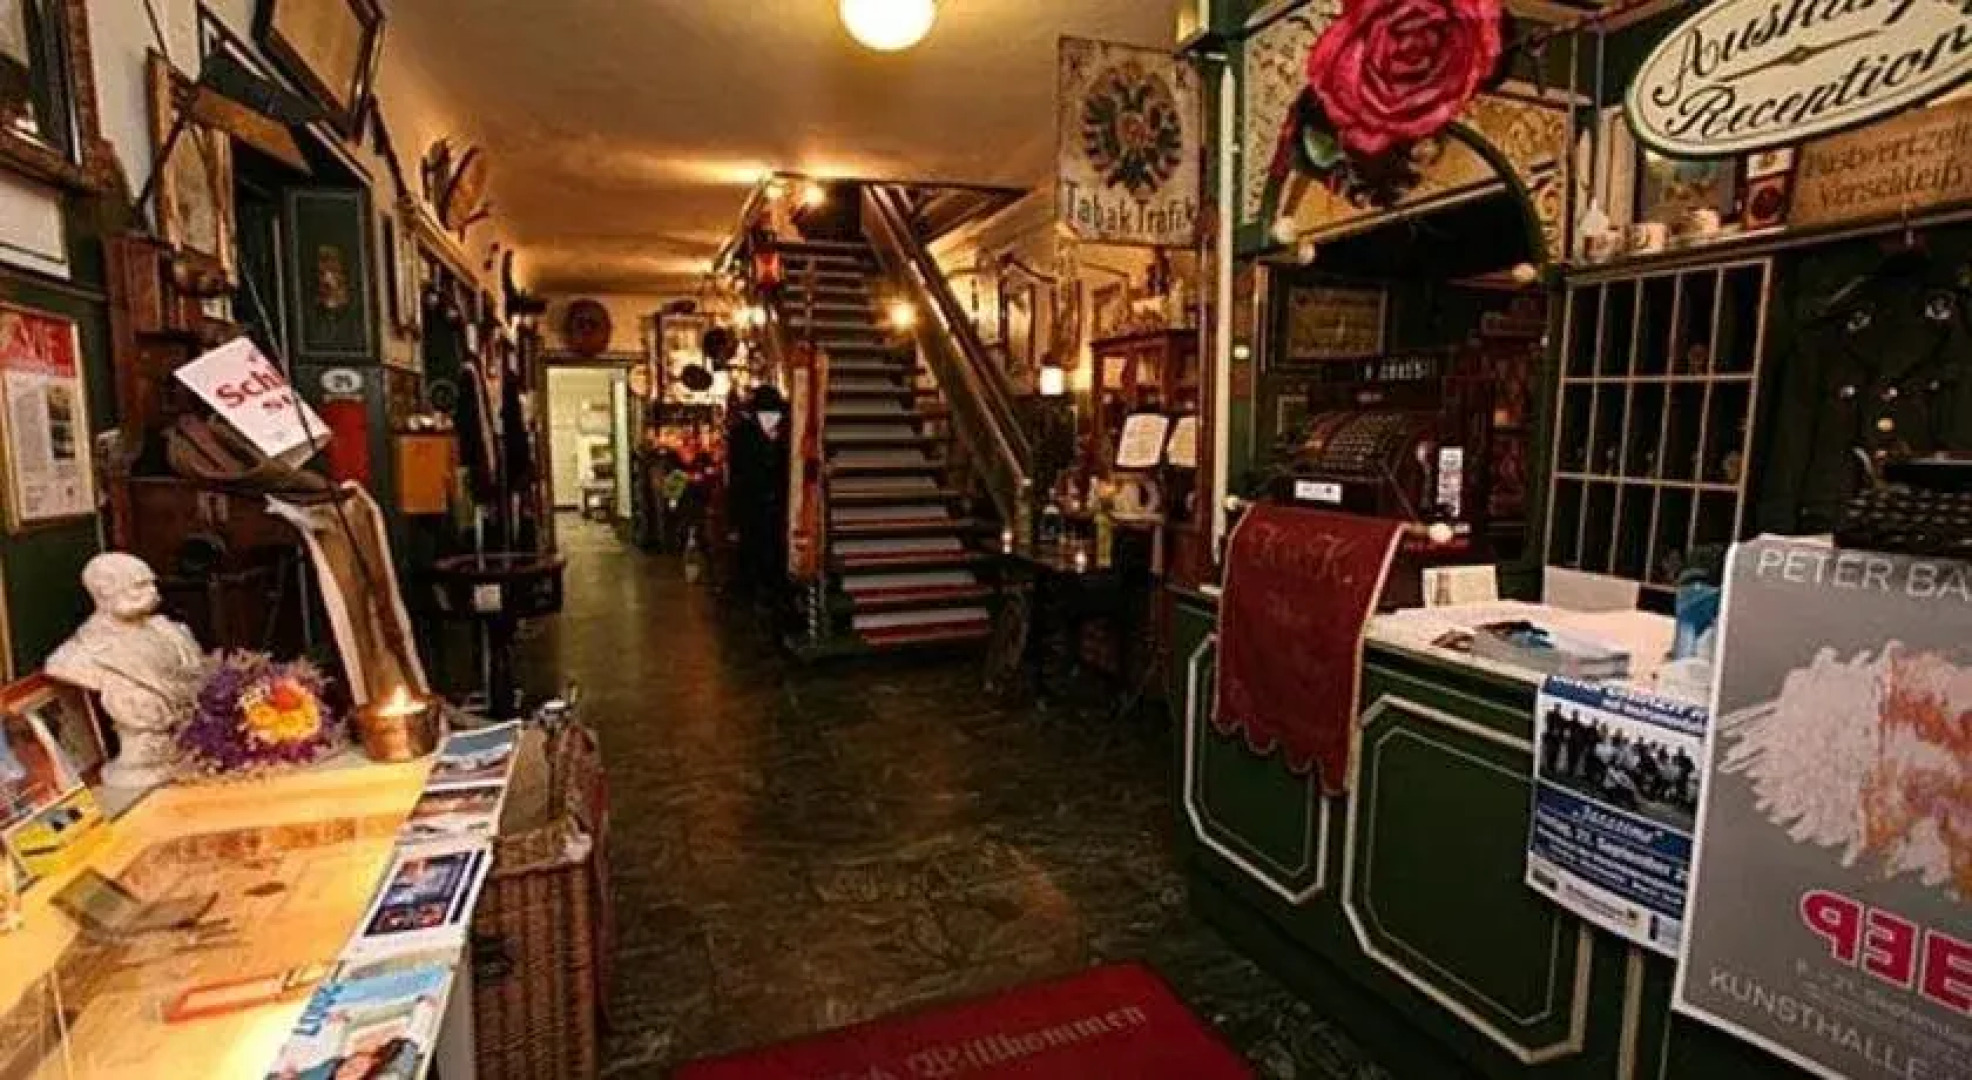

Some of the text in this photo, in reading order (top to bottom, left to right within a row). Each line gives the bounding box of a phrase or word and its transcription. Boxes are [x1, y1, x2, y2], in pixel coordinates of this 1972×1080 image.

[1664, 24, 1972, 138] Reception
[1064, 180, 1131, 231] Tabak
[1757, 549, 1892, 590] PETER
[1708, 965, 1938, 1080] KUNSTHALLE
